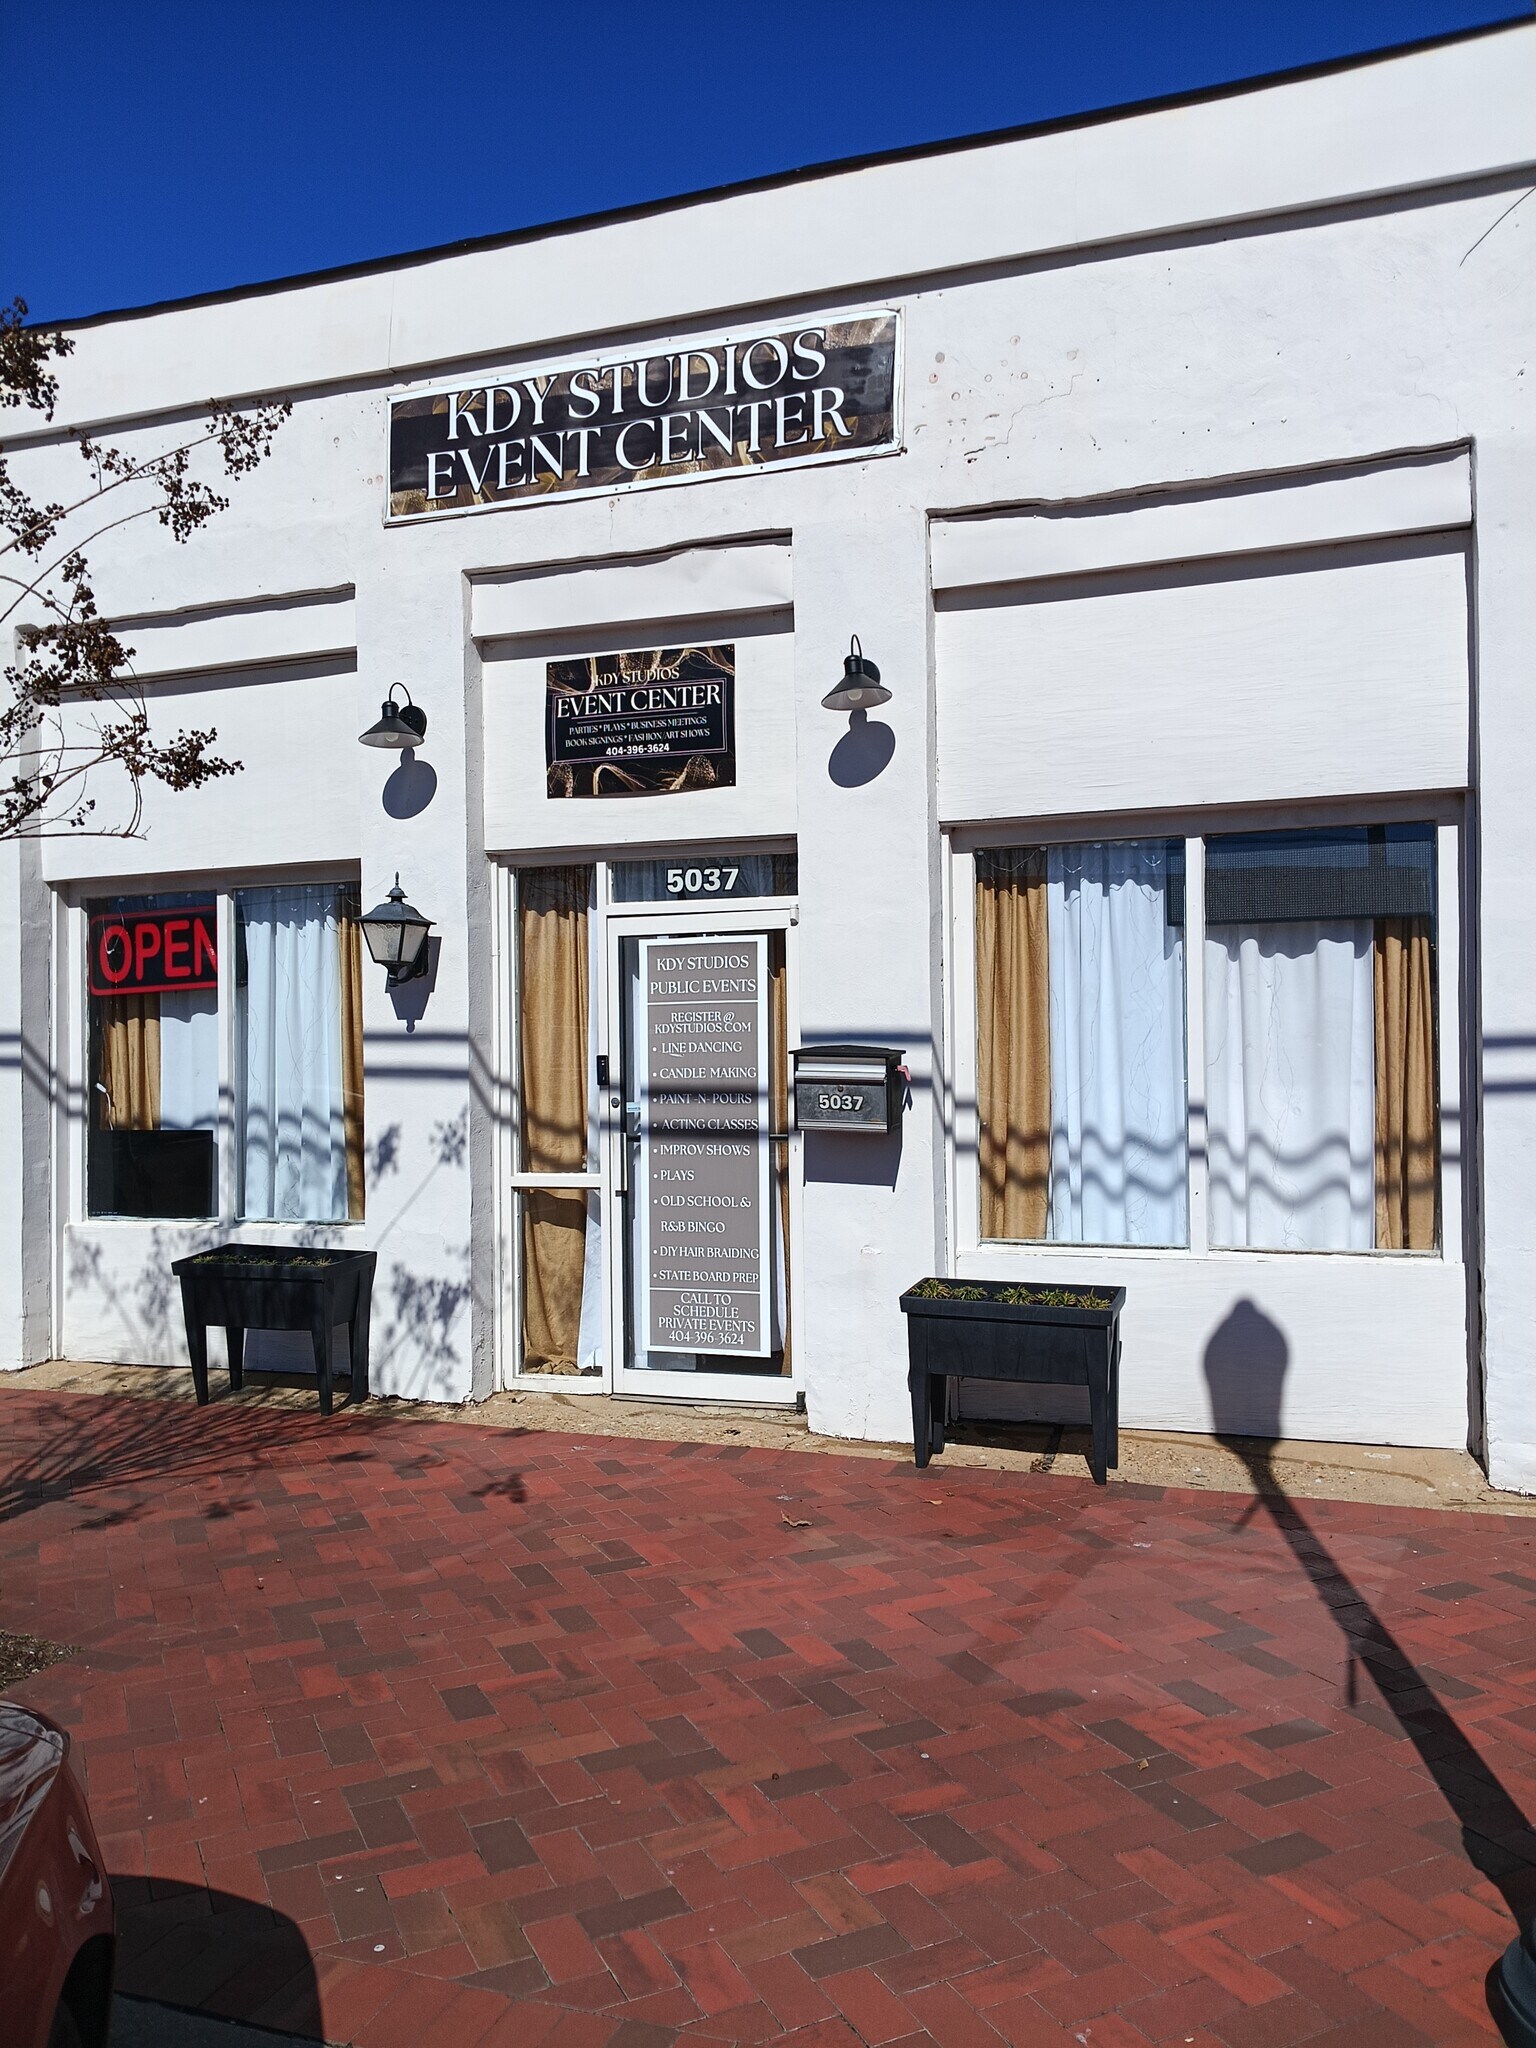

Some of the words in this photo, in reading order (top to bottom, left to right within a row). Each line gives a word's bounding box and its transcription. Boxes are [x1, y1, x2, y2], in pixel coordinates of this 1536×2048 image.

[446, 375, 560, 441] KDY
[567, 328, 827, 419] STUDIOS
[426, 429, 602, 500] EVENT
[615, 386, 852, 471] CENTER
[595, 672, 620, 687] KDY
[622, 667, 680, 684] STUDIOS
[557, 691, 626, 718] EVENT
[630, 684, 721, 710] CENTER
[569, 725, 598, 736] PARTIES
[603, 723, 626, 732] PLAYS
[631, 719, 667, 730] BUSINESS
[667, 716, 708, 727] MEETINGS
[565, 738, 588, 748] BOOK
[588, 735, 623, 746] SIGNINGS
[680, 728, 711, 738] SHOWS
[605, 743, 670, 756] 404-396-3624
[666, 866, 740, 894] 5037
[100, 918, 217, 982] OPEN
[656, 957, 685, 971] KDY
[687, 955, 749, 970] STUDIOS
[650, 980, 700, 995] PUBLIC
[702, 978, 756, 993] EVENTS
[671, 1011, 721, 1022] REGISTER
[723, 1011, 735, 1024] @
[655, 1022, 751, 1034] KDYSTUDIOS.COM
[662, 1042, 687, 1054] LINE
[689, 1041, 742, 1053] DANCING
[660, 1067, 706, 1079] CANDLE
[710, 1067, 757, 1078] MAKING
[660, 1093, 693, 1104] PAINT
[712, 1093, 752, 1104] POURS
[818, 1094, 864, 1110] 5037
[662, 1118, 705, 1130] ACTING
[707, 1119, 758, 1130] CLASSES
[660, 1144, 705, 1155] IMPROV
[706, 1144, 751, 1156] SHOWS
[660, 1169, 695, 1181] PLAYS
[660, 1195, 685, 1206] OLD
[687, 1195, 738, 1207] SCHOOL
[740, 1197, 751, 1208] &
[660, 1221, 686, 1232] R&B
[687, 1221, 726, 1233] BINGO
[659, 1246, 678, 1257] DIY
[679, 1246, 705, 1258] HAIR
[707, 1247, 759, 1259] BRAIDING
[659, 1270, 691, 1280] STATE
[692, 1271, 731, 1282] BOARD
[733, 1272, 759, 1284] PREP
[680, 1292, 712, 1305] CALL
[713, 1293, 732, 1306] TO
[673, 1304, 739, 1319] SCHEDULE
[658, 1317, 707, 1331] PRIVATE
[709, 1319, 756, 1333] EVENTS
[668, 1330, 745, 1345] 404-396-3624
